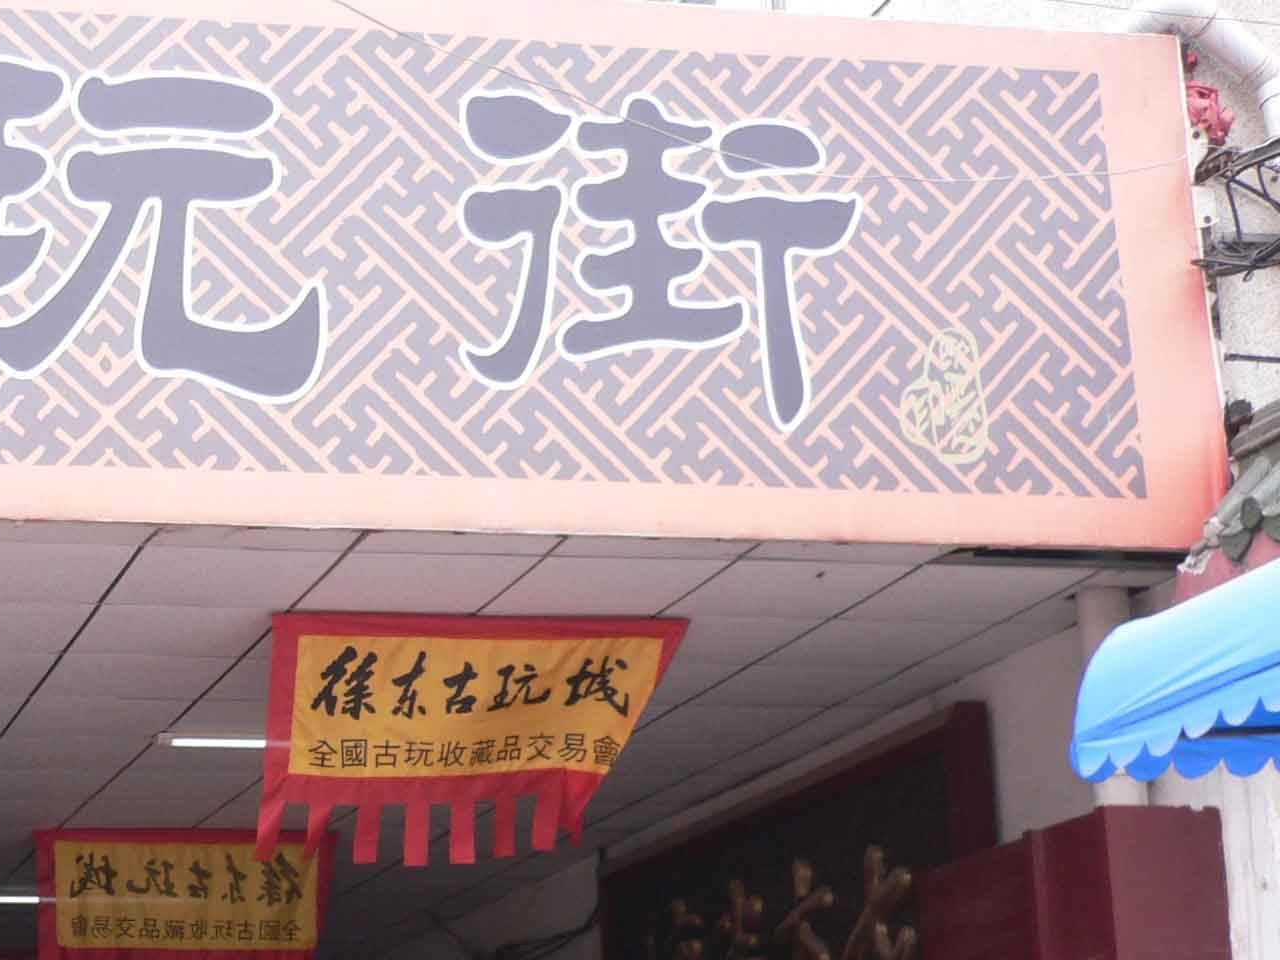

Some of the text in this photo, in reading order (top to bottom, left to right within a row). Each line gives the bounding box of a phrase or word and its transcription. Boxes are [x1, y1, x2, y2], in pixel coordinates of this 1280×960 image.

[308, 732, 621, 770] 全國古玩收藏品交易會
